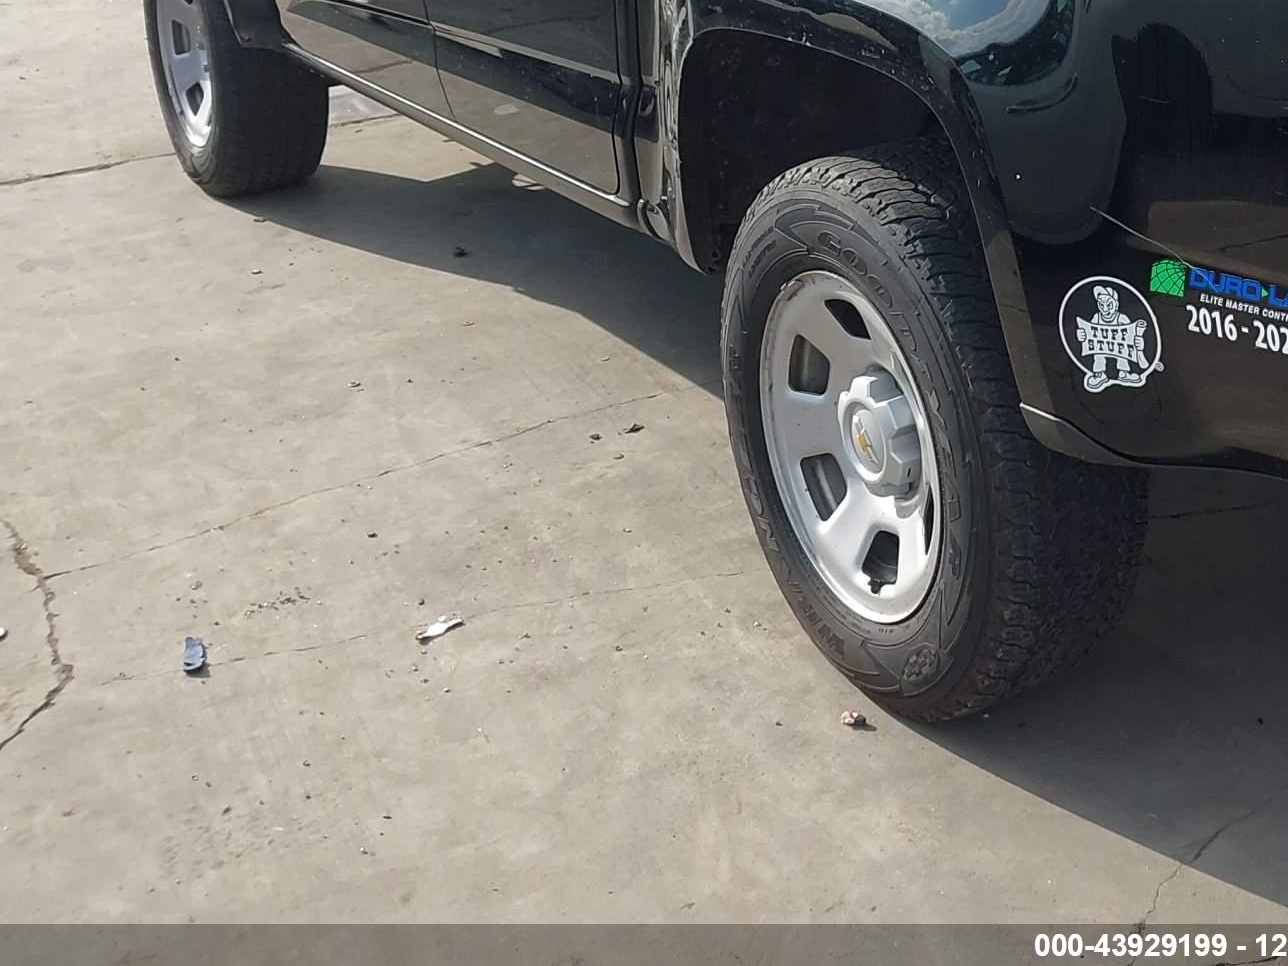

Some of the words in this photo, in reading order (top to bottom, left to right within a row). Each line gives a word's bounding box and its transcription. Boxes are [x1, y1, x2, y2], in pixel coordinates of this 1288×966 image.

[1200, 292, 1224, 307] ELITE
[1225, 298, 1260, 315] MASTER
[1090, 326, 1128, 342] TUFF
[1186, 304, 1238, 342] 2016
[1087, 338, 1135, 359] STUFF
